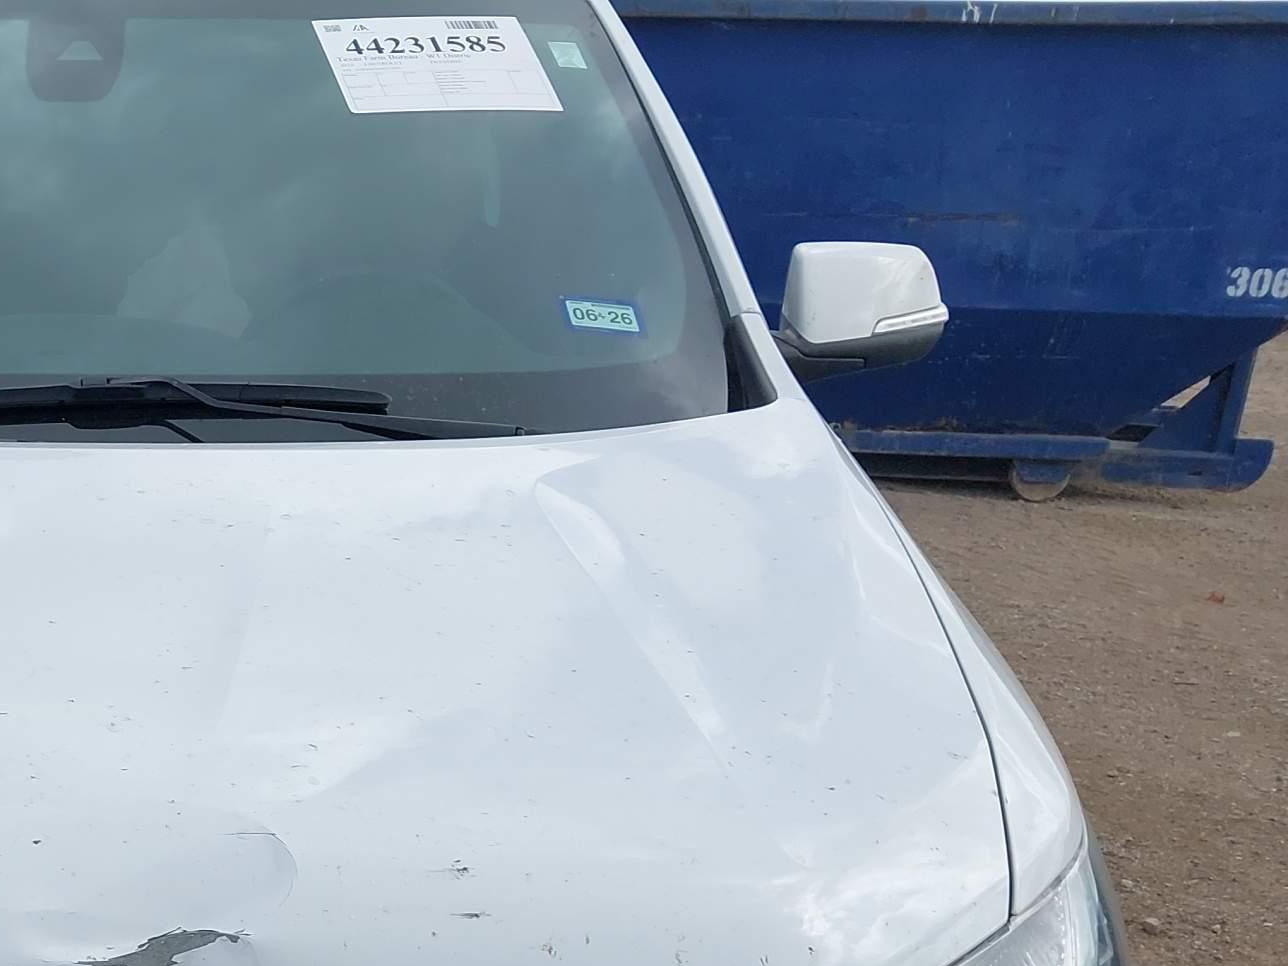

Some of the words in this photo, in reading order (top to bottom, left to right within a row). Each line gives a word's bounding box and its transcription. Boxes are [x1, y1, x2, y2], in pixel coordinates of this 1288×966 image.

[345, 35, 507, 55] 44231585
[573, 307, 599, 322] 06
[608, 311, 633, 325] 26
